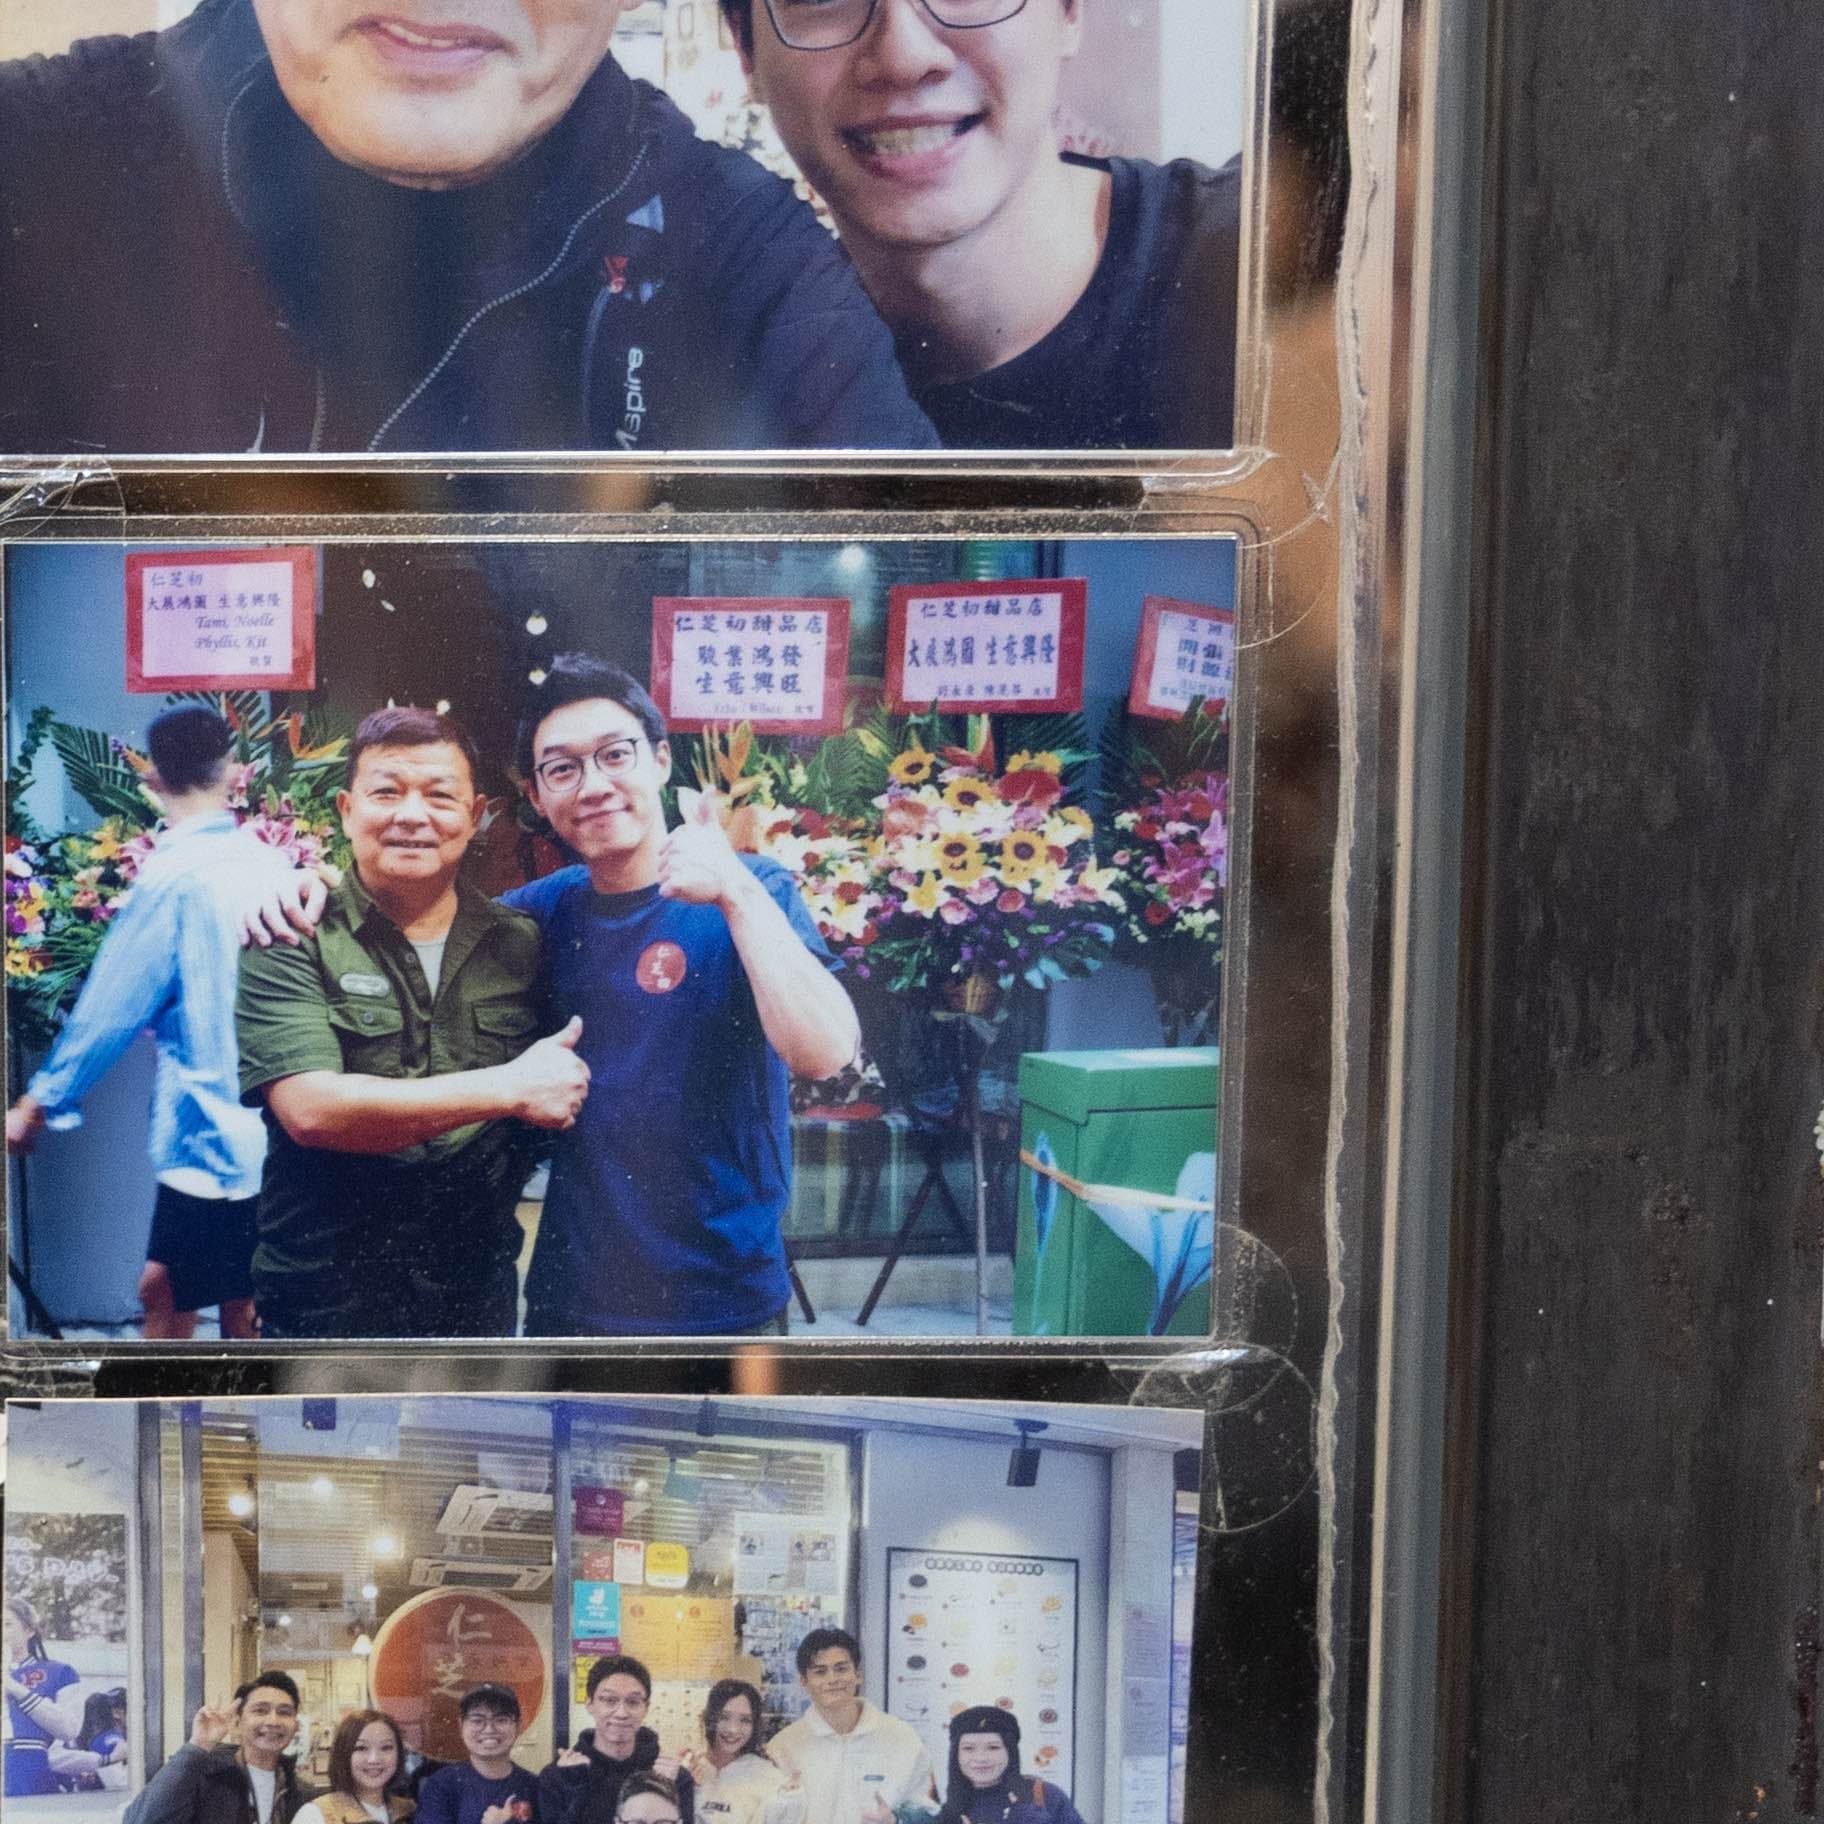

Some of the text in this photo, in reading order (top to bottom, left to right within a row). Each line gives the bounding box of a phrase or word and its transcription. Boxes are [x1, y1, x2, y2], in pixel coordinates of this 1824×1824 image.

[920, 596, 1044, 619] 仁芝初甜品店
[675, 614, 824, 634] 仁芝初甜品店
[695, 671, 802, 695] 生意興旺
